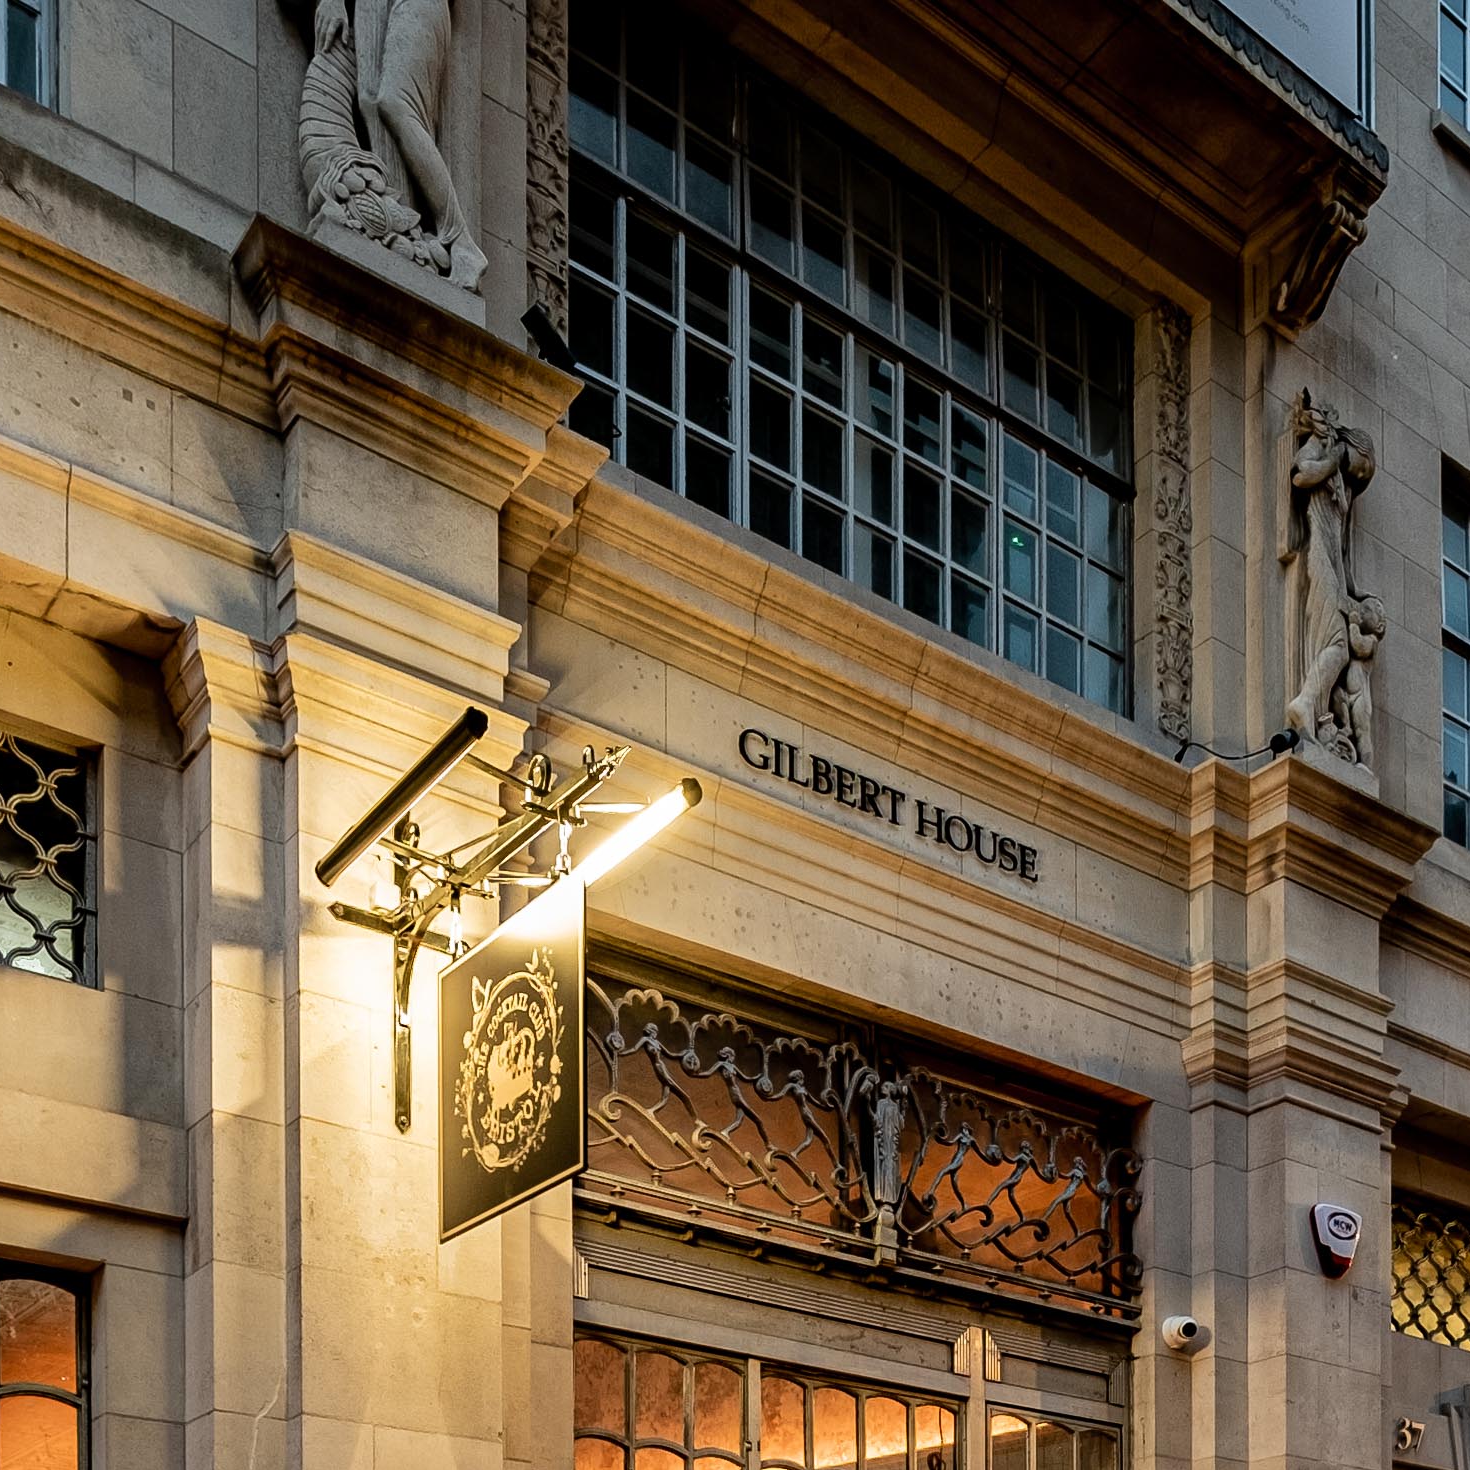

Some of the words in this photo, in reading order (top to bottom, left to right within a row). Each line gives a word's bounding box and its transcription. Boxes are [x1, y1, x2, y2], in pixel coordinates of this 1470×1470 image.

[737, 728, 906, 826] GILBERT
[914, 798, 1039, 883] HOUSE
[487, 993, 528, 1038] COCKTAIL
[528, 1001, 546, 1041] CLUB
[1395, 1415, 1427, 1451] 37
